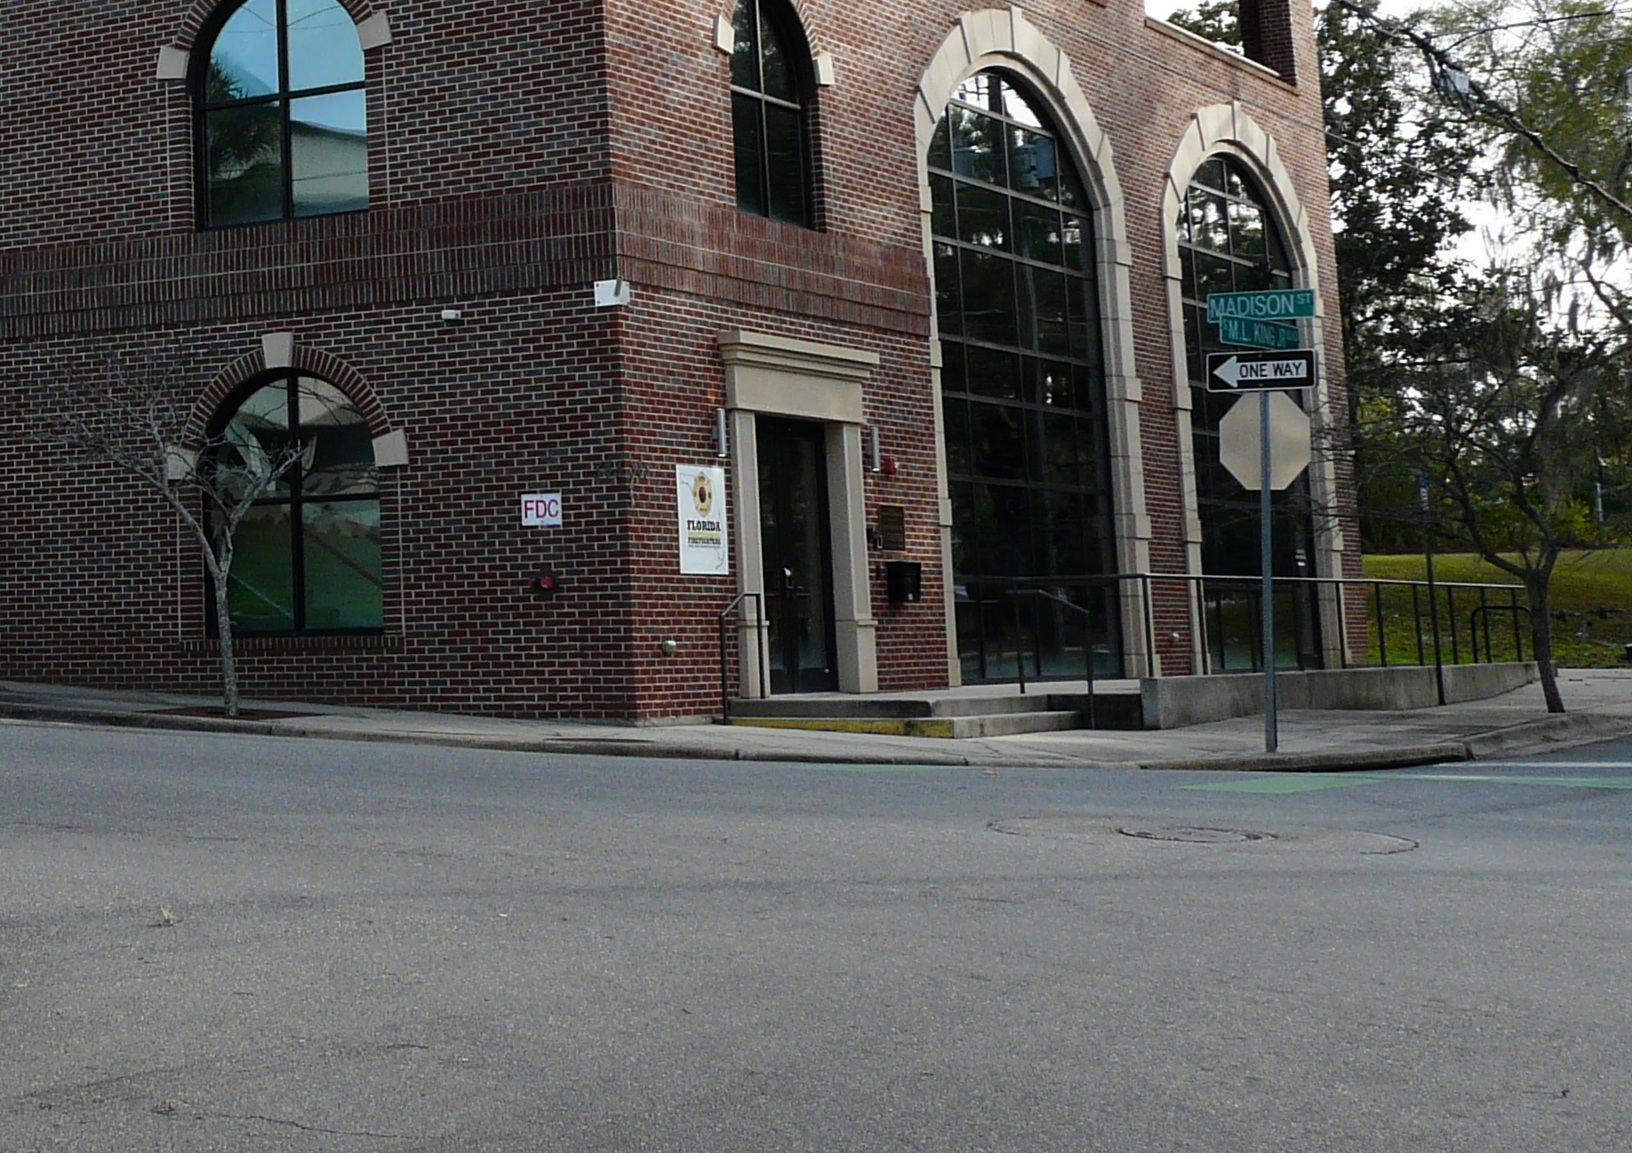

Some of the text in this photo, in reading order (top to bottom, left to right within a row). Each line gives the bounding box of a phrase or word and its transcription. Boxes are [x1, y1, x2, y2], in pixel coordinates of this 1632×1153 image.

[1209, 292, 1312, 318] MADISON ST
[1254, 323, 1276, 346] KING
[1239, 361, 1303, 378] ONE WAY
[524, 499, 560, 519] FDC
[686, 519, 721, 532] FLORIDA
